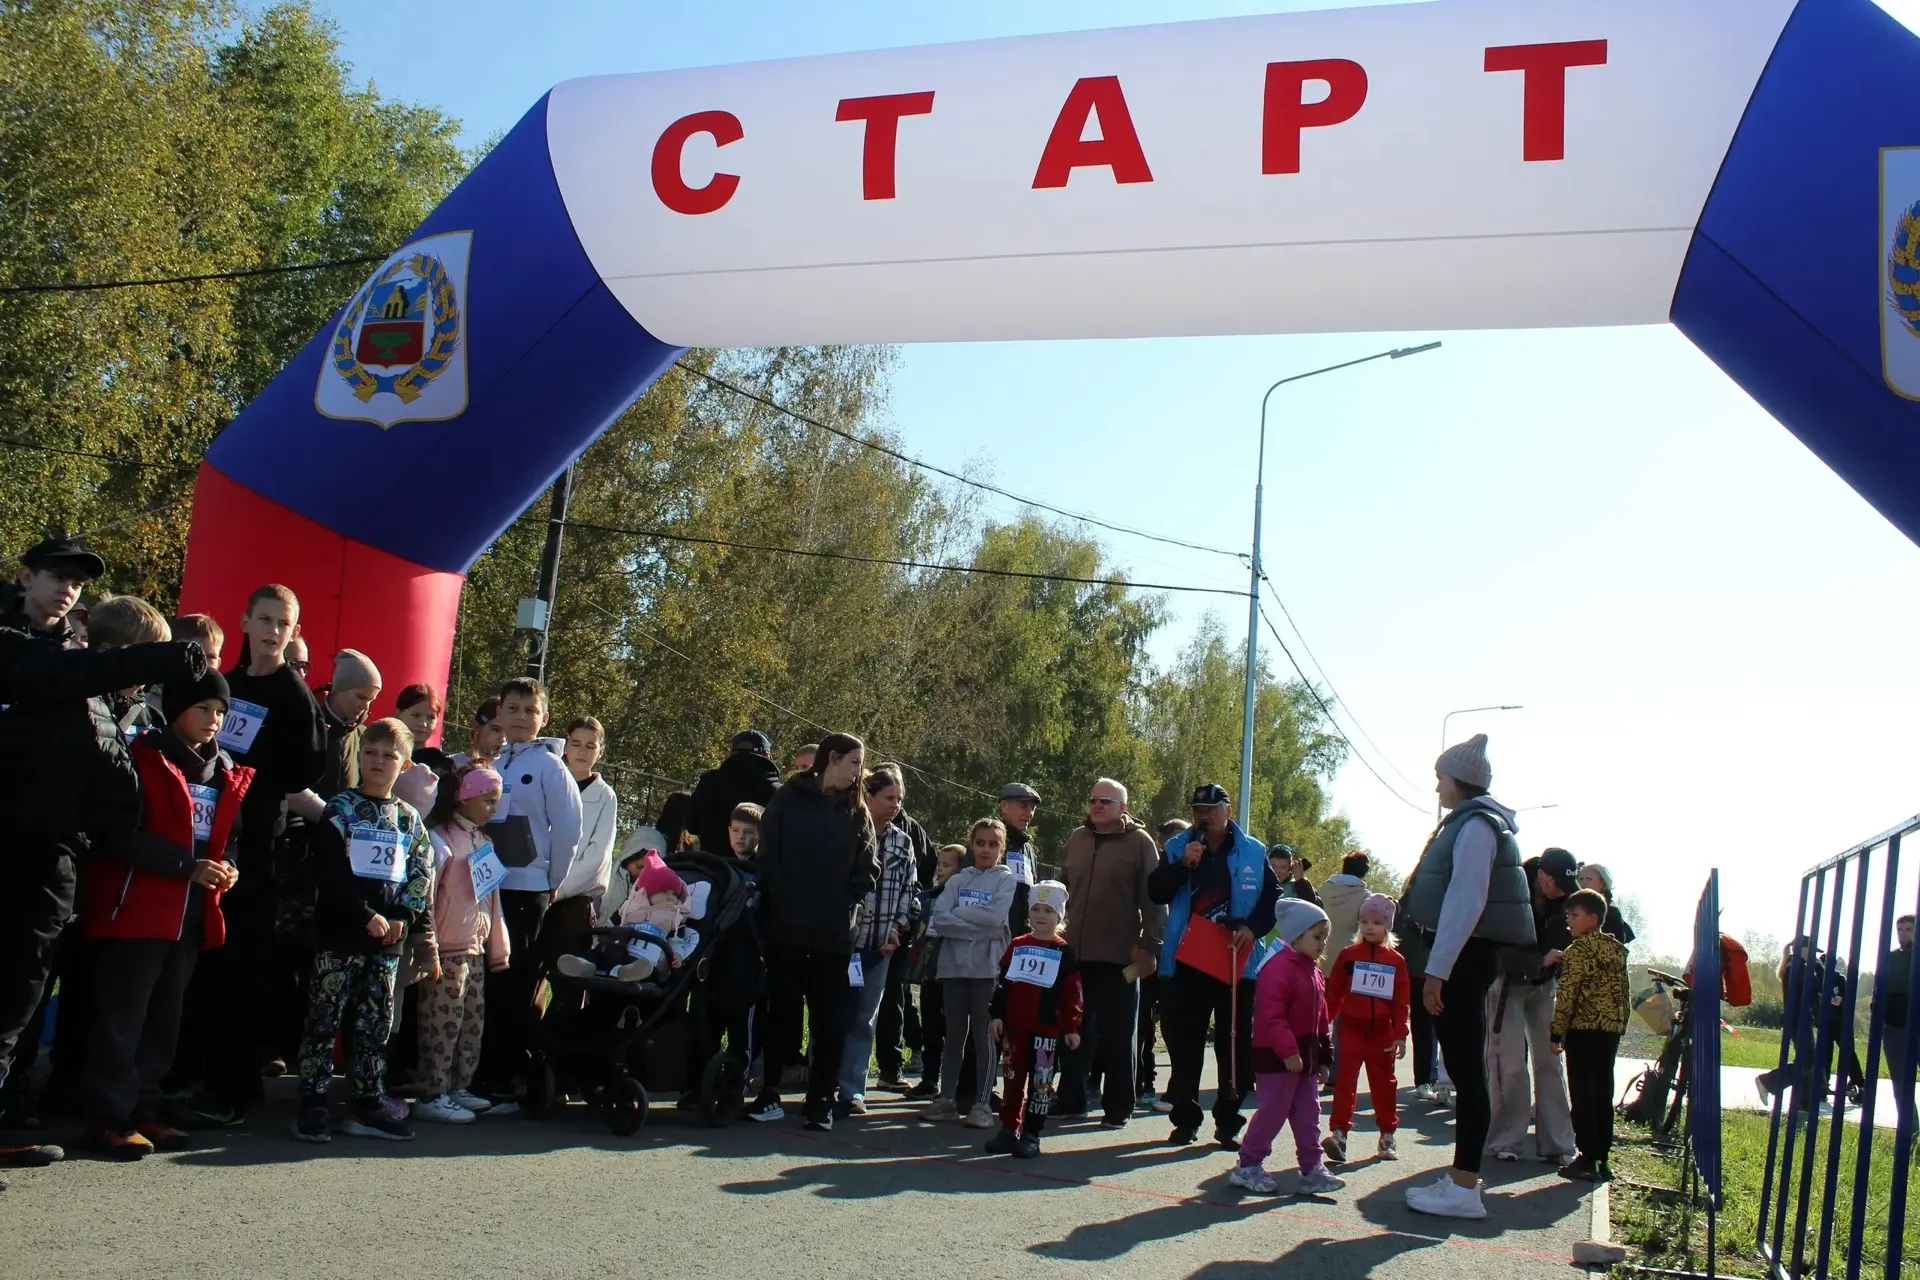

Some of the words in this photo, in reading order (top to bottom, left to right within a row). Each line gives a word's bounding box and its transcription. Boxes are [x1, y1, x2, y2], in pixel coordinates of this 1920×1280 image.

[652, 41, 1606, 214] СТАРТ
[222, 714, 248, 737] 102
[370, 845, 396, 867] 28
[1019, 957, 1046, 976] 191
[1361, 973, 1386, 989] 170
